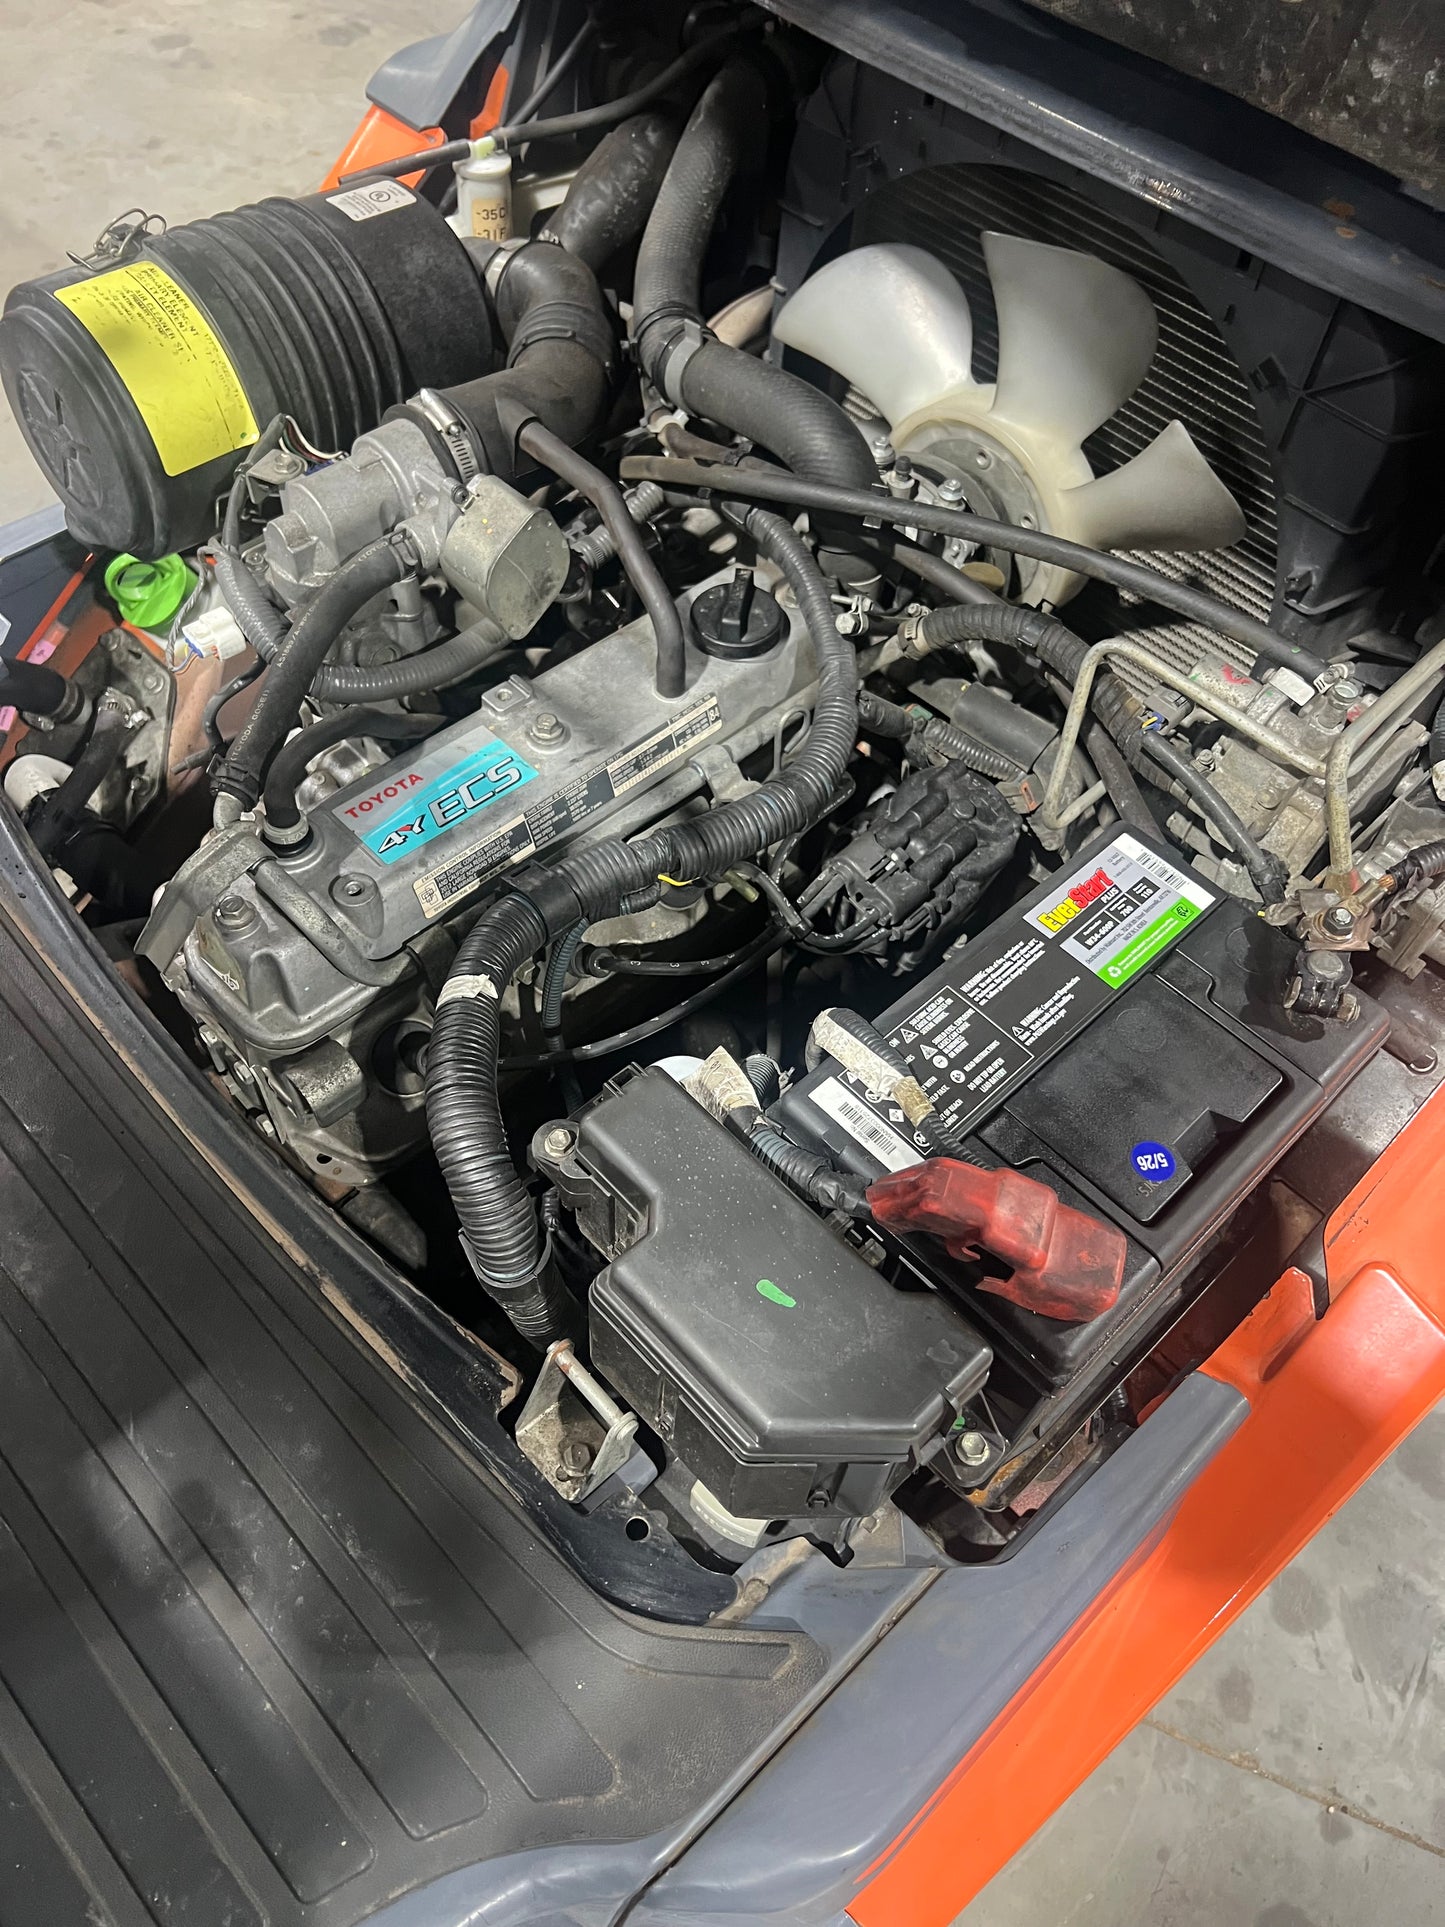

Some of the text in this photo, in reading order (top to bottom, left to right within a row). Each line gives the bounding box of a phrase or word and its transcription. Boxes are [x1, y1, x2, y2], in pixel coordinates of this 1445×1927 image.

[709, 705, 720, 722] 84
[344, 772, 424, 820] TOYOTA
[378, 756, 523, 854] 4Y ECS
[421, 864, 445, 883] EMISSION
[445, 850, 468, 868] CONTROL
[468, 829, 502, 853] INFORMATION
[435, 872, 445, 883] THIS
[446, 861, 462, 876] ENGINE
[462, 848, 484, 866] COMPLIES
[483, 840, 496, 852] WITH
[504, 830, 513, 839] EPA
[437, 877, 448, 888] AND
[447, 861, 473, 882] CALIFORNIA
[472, 844, 500, 866] REGULATIONS
[500, 837, 510, 848] FOR
[1036, 868, 1116, 933] EverStart
[1099, 886, 1120, 904] PLUS
[1119, 903, 1134, 917] 700
[1139, 887, 1154, 899] 110
[978, 1067, 1007, 1093] LEAD BATTERY
[1136, 1152, 1169, 1171] 5/26
